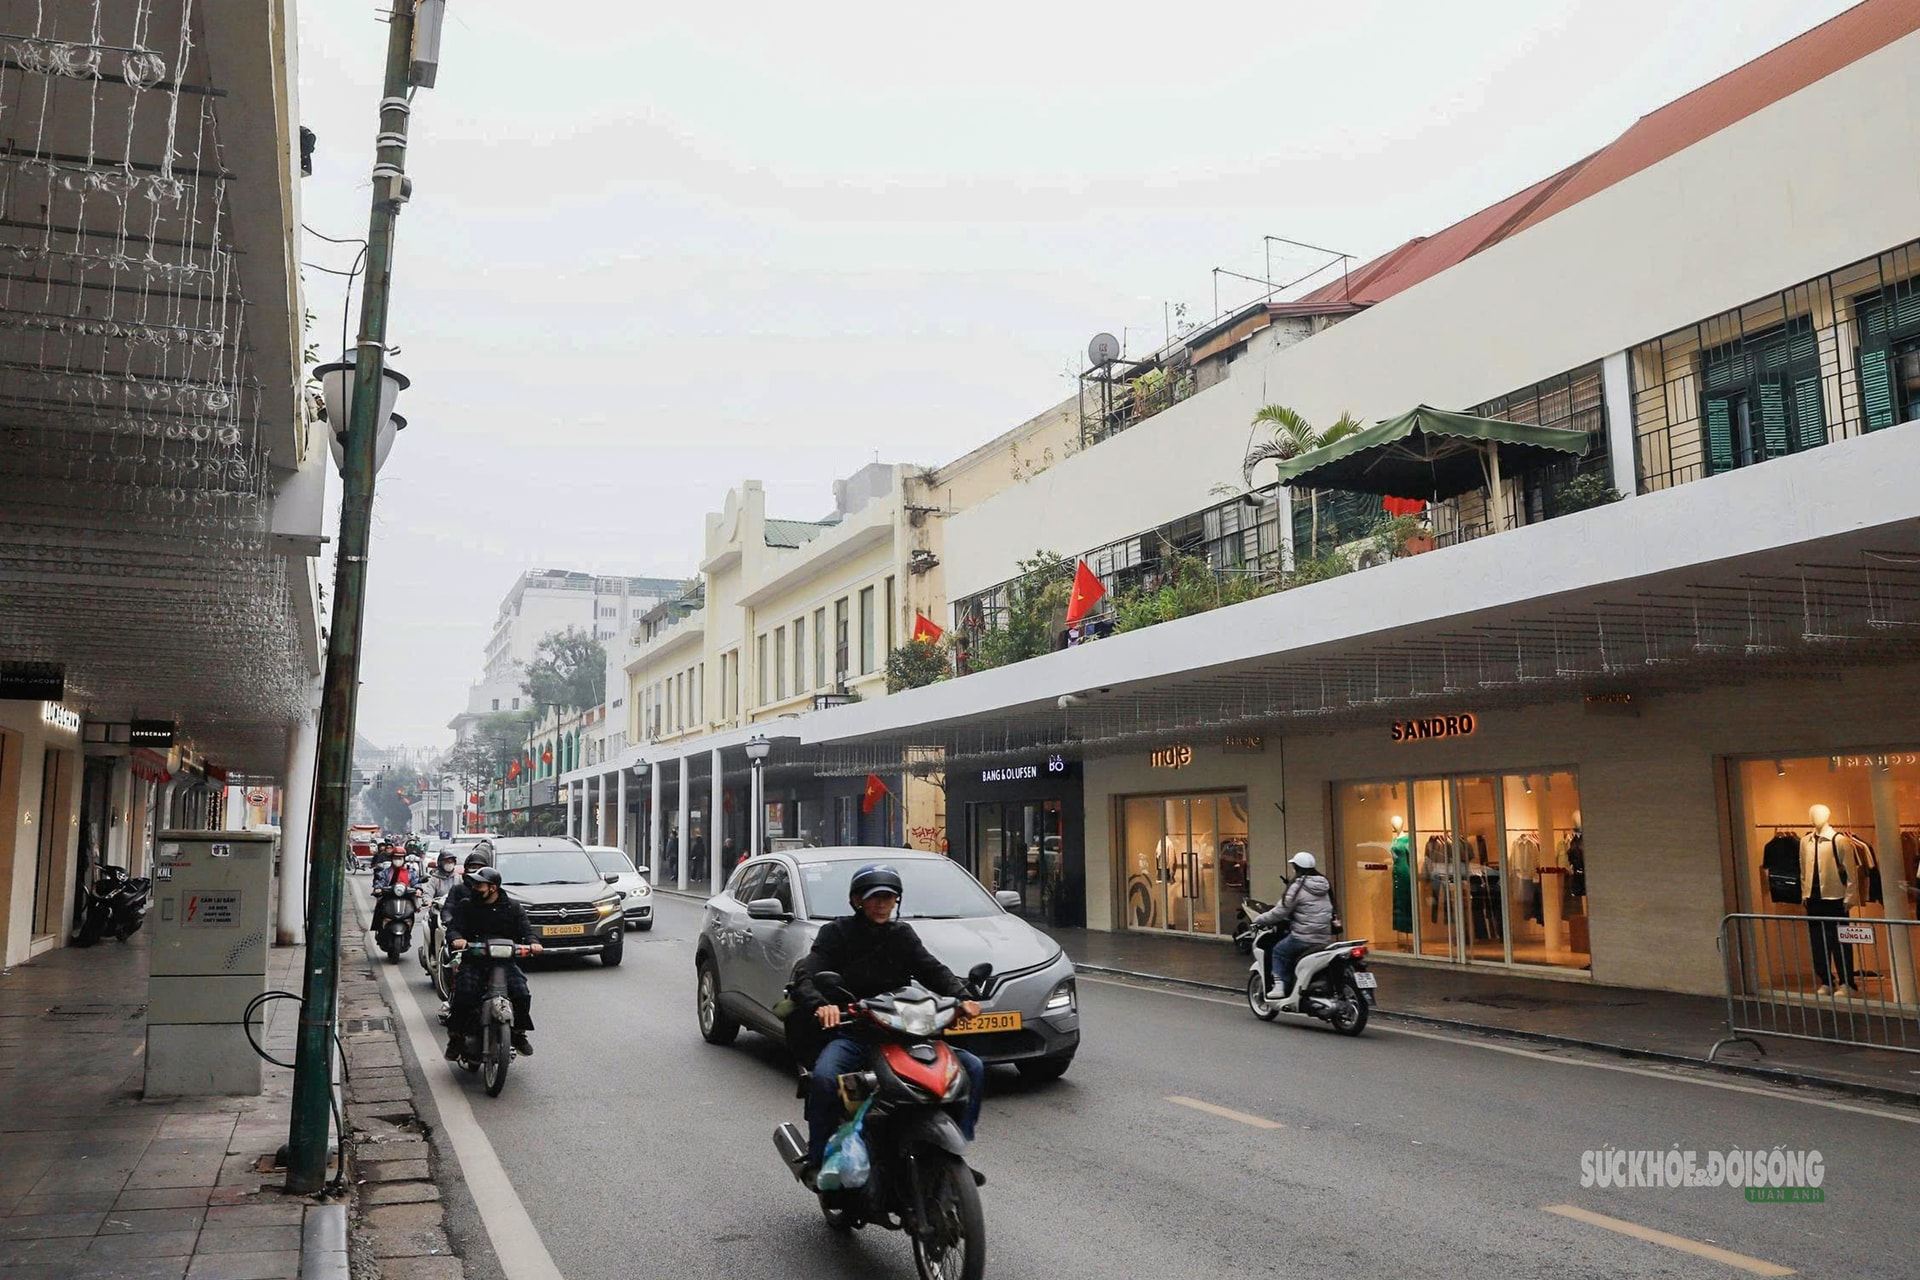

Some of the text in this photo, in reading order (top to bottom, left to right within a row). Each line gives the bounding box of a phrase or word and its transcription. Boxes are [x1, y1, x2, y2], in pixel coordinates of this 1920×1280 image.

[1391, 713, 1475, 741] SANDRO
[1150, 745, 1191, 769] maje
[951, 1016, 1014, 1031] 9E-279.01
